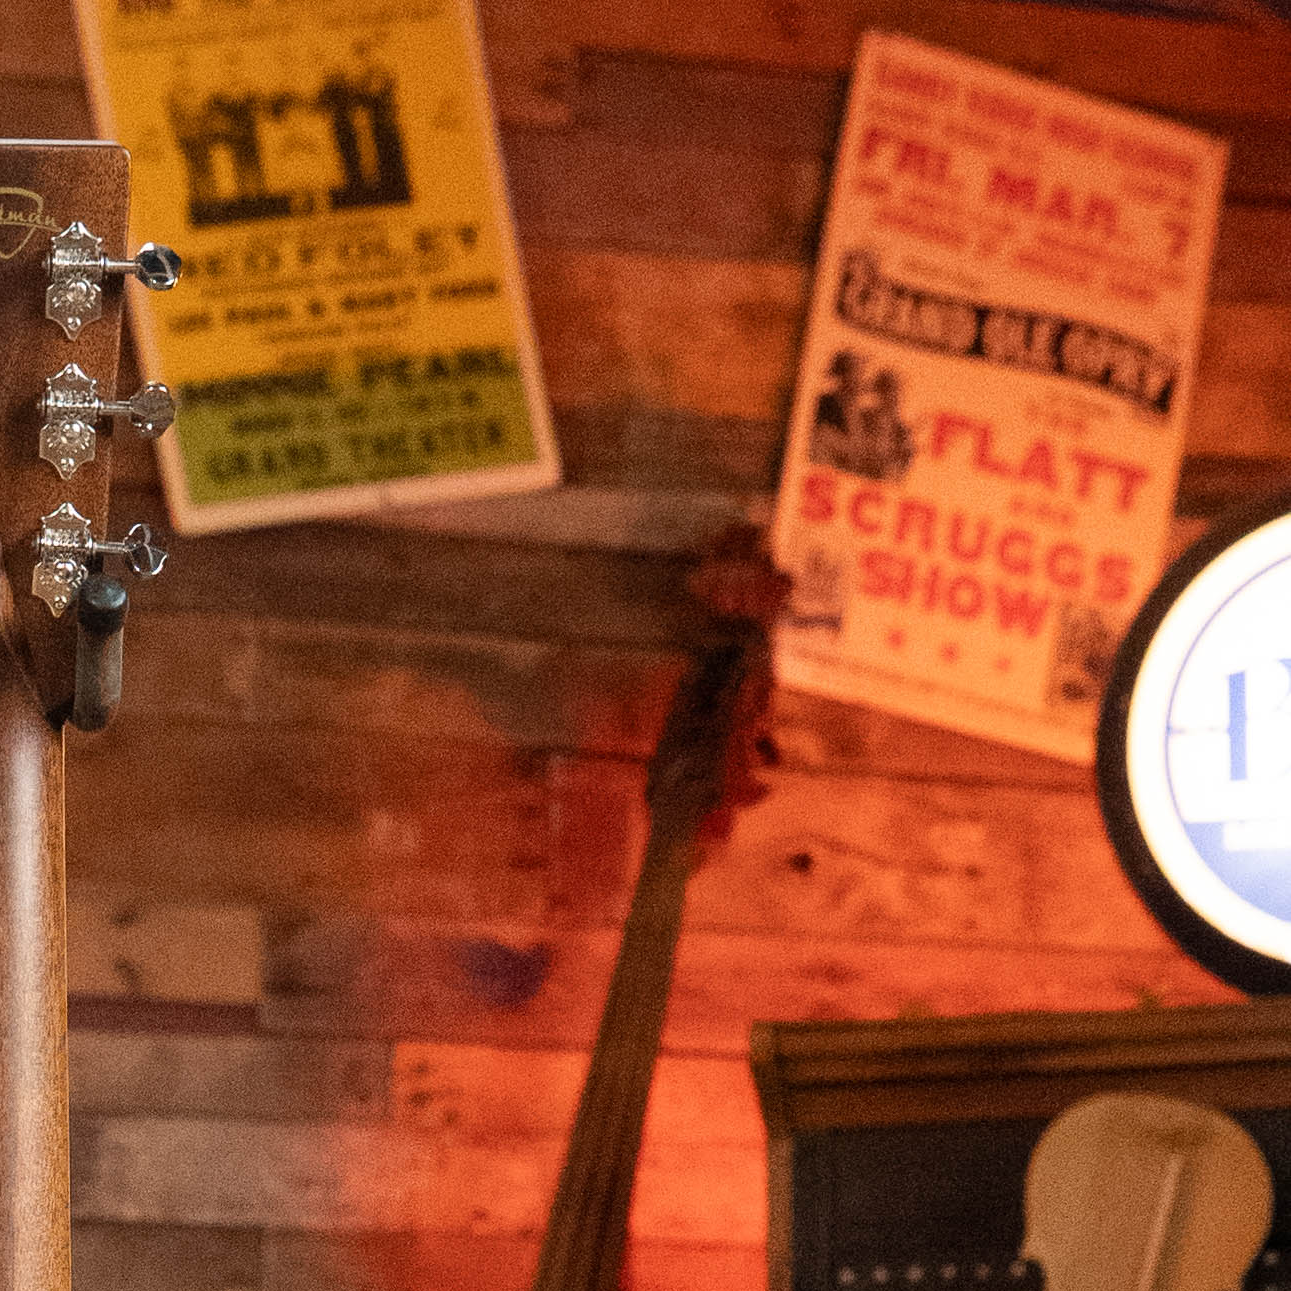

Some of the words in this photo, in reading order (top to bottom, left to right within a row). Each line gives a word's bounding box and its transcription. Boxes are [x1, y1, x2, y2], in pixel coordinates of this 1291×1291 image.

[930, 411, 1150, 514] FLATT
[800, 473, 1136, 605] SCRUGGS
[859, 547, 1051, 641] SHOW
